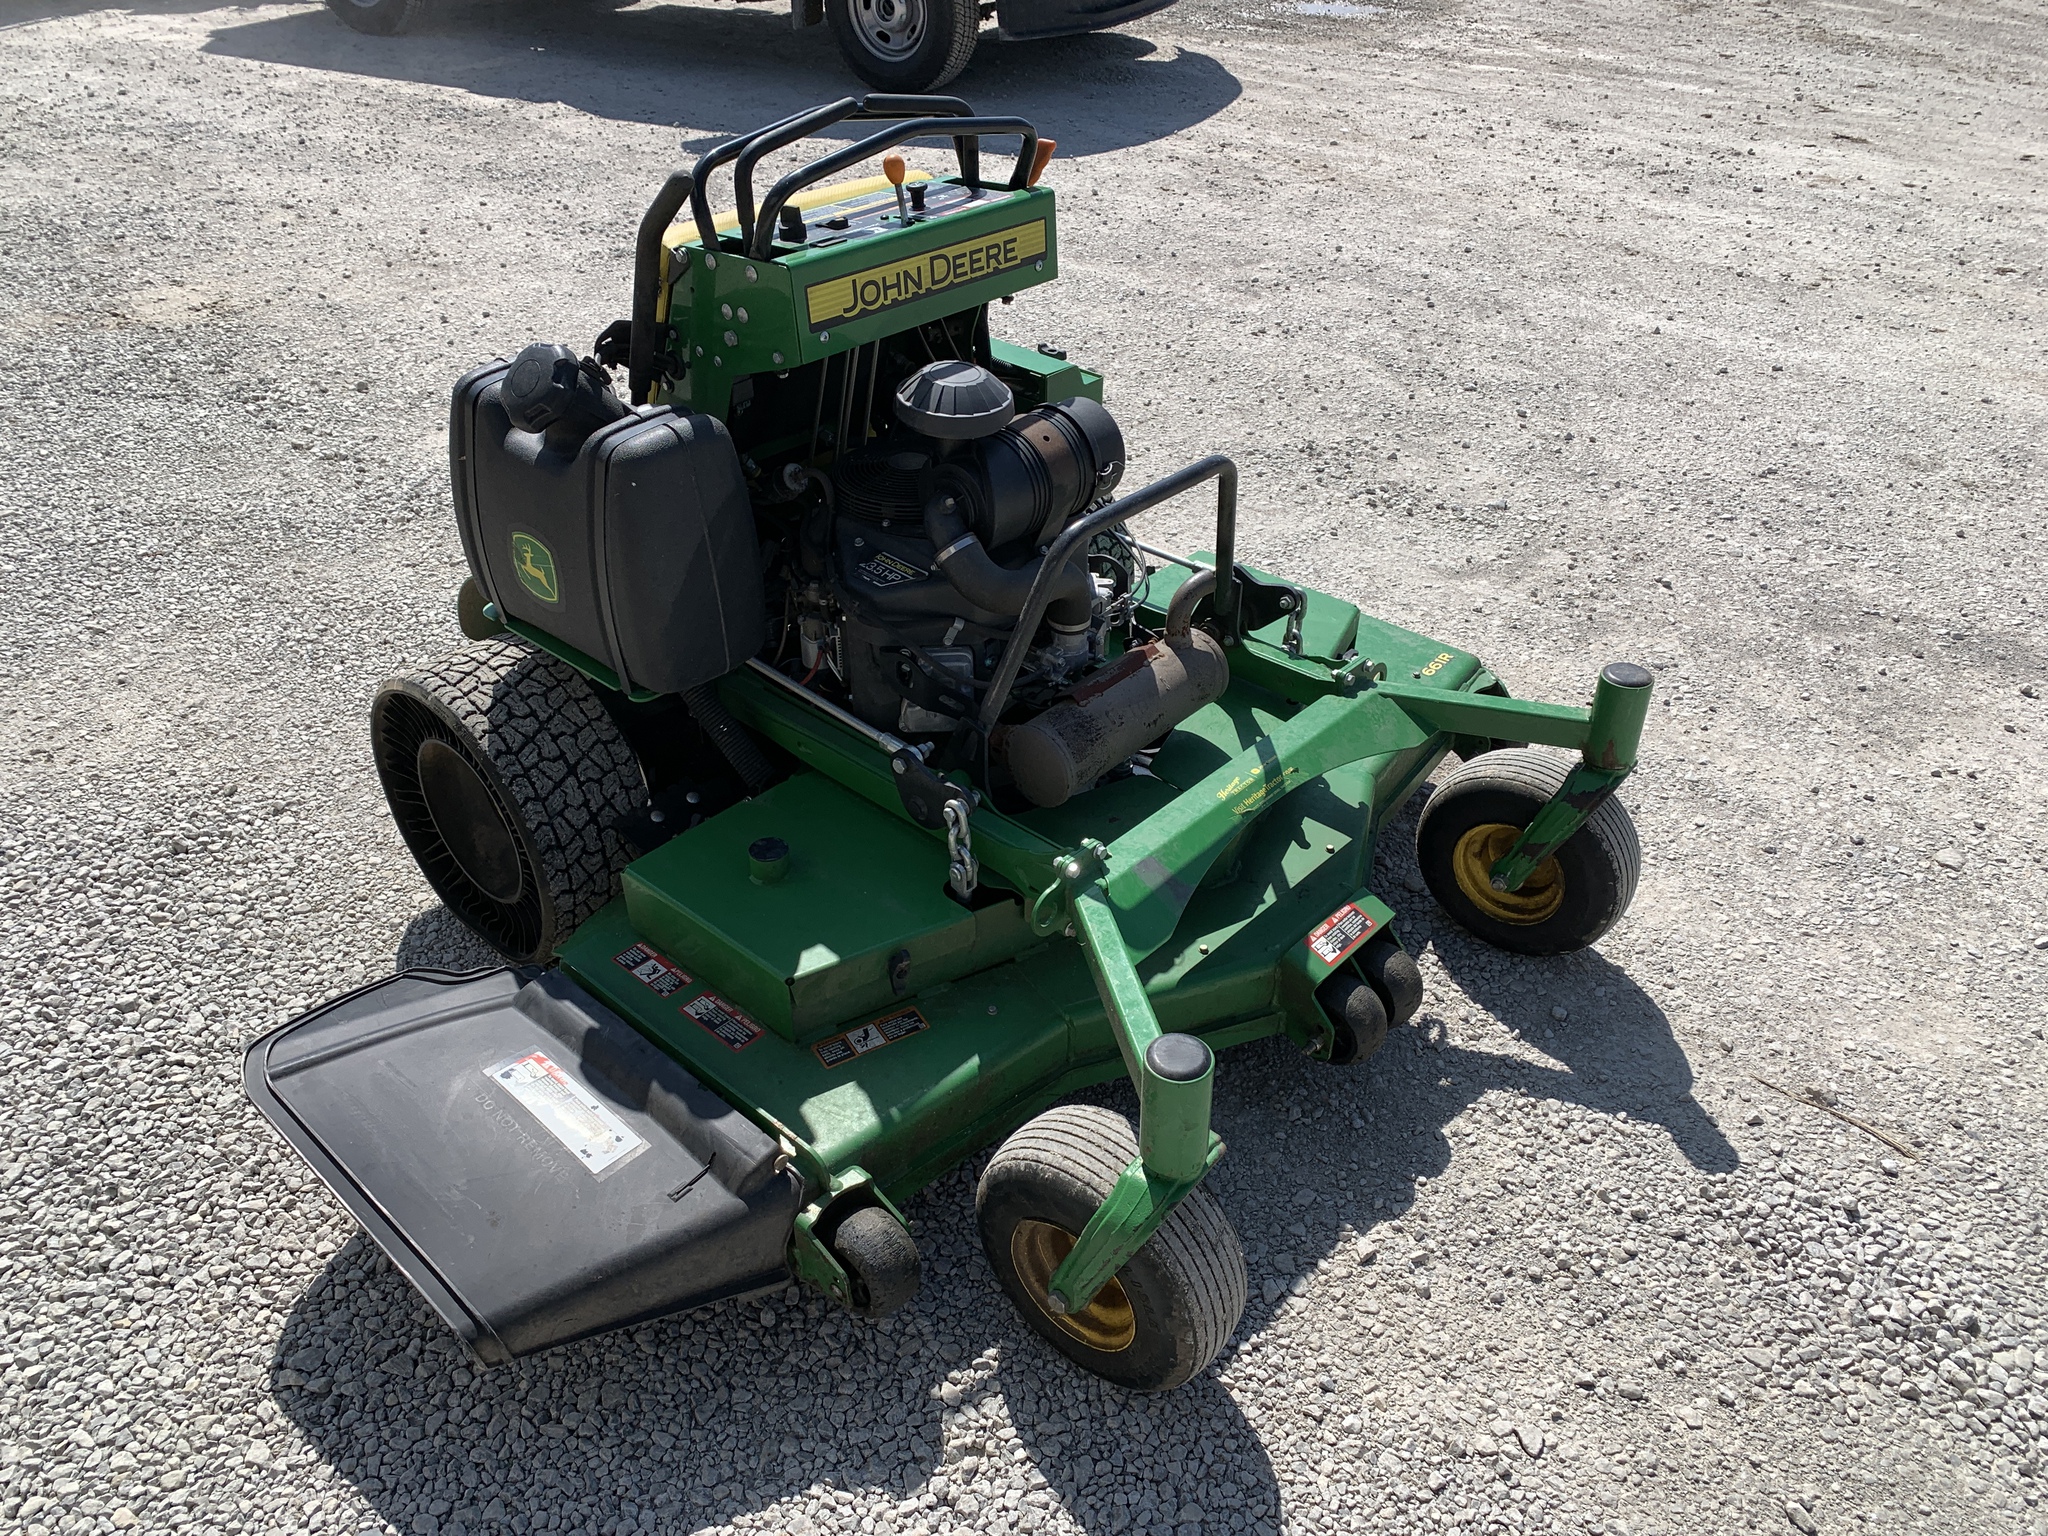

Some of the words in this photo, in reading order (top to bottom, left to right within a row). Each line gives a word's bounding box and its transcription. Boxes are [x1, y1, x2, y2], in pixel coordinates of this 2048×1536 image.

[842, 265, 923, 314] JOHN
[928, 236, 1019, 287] DEERE
[881, 569, 902, 581] HP
[1421, 652, 1455, 677] 661R
[1231, 802, 1247, 815] Visit
[714, 998, 734, 1014] DANGER
[474, 1092, 494, 1111] DO
